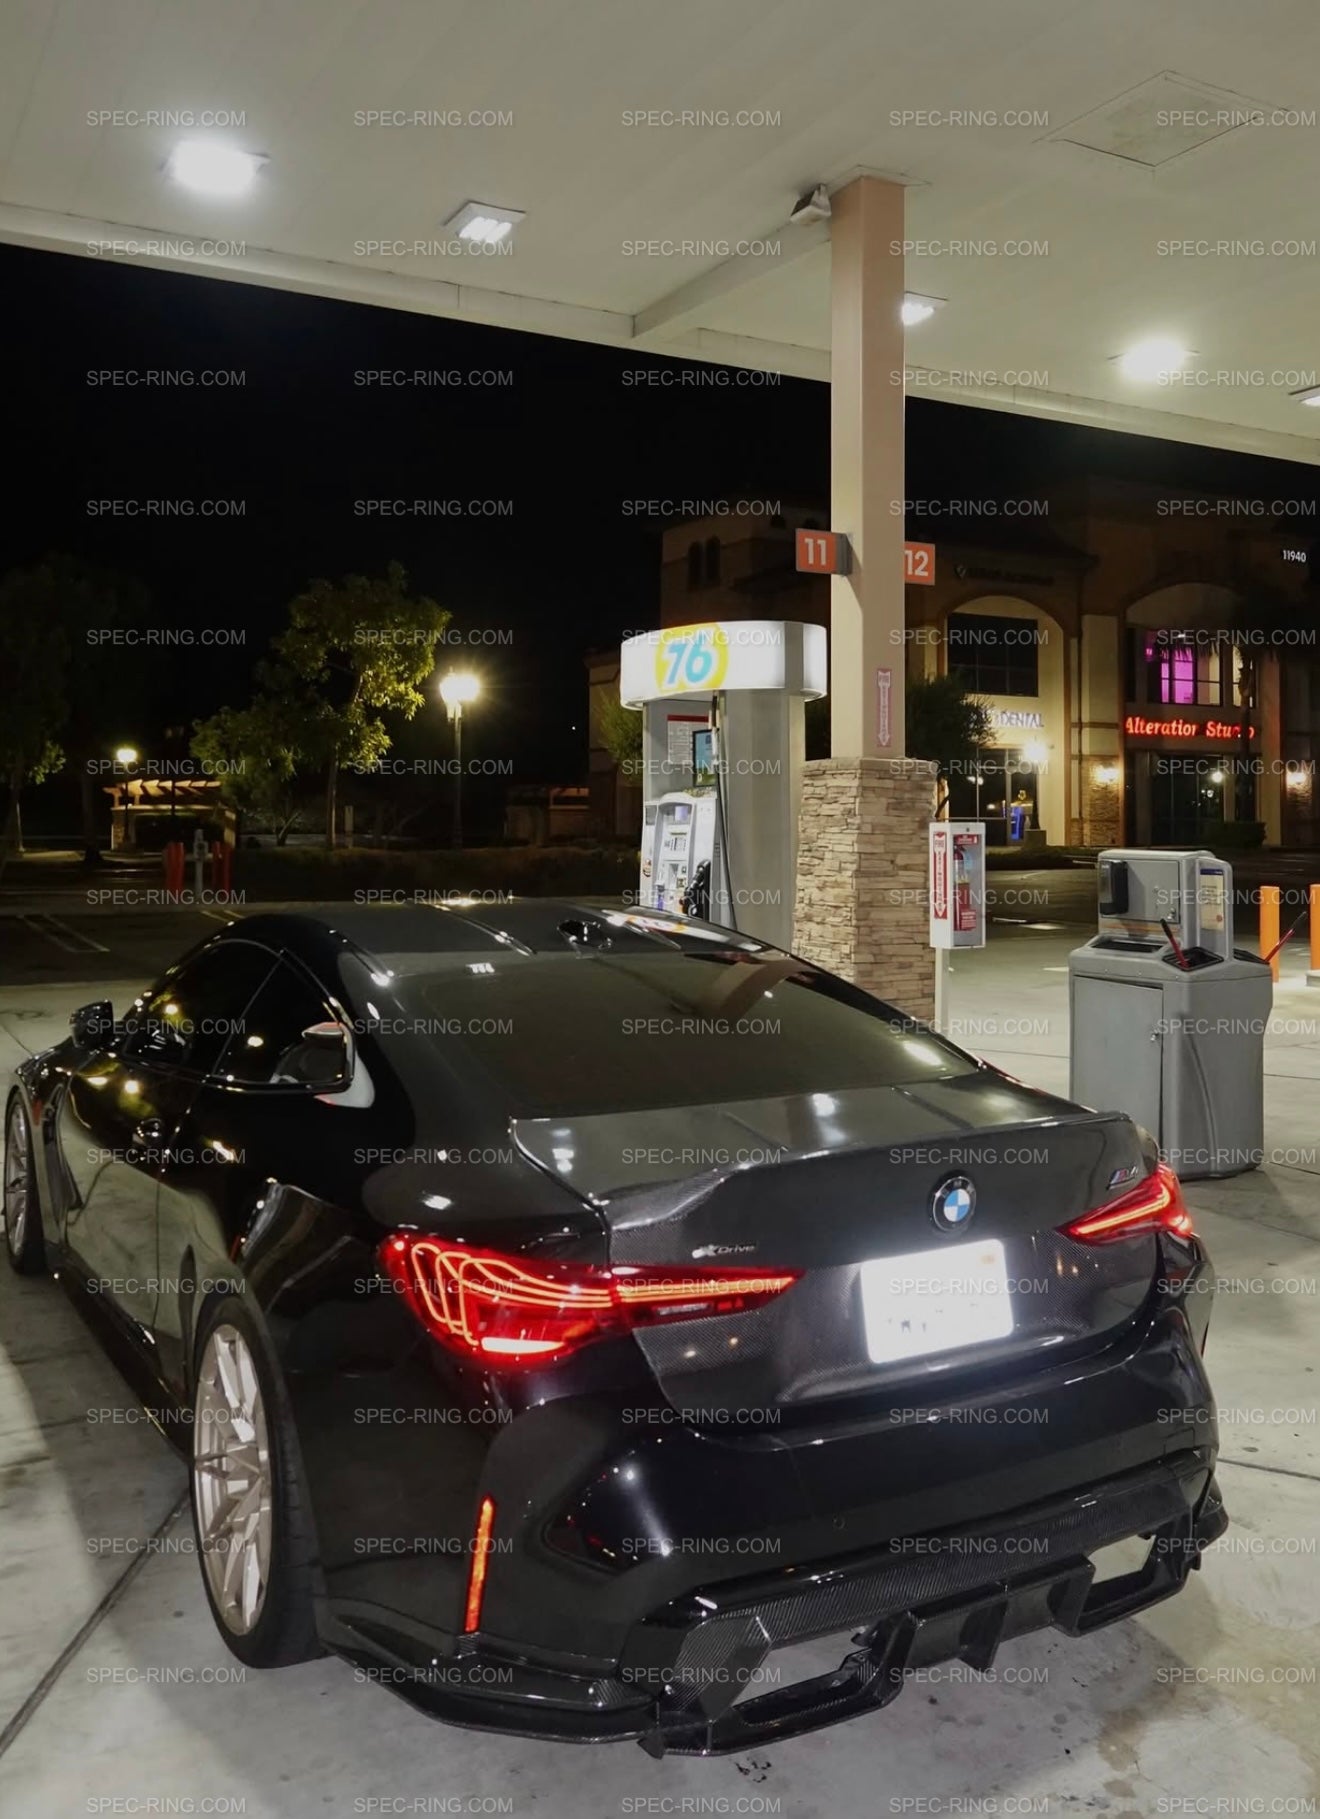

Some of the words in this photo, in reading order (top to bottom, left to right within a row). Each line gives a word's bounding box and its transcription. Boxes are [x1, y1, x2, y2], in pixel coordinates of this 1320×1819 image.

[804, 537, 827, 566] 11
[904, 549, 929, 577] 12
[1283, 549, 1307, 563] 11940
[665, 630, 714, 685] 76
[1001, 711, 1045, 728] DENTAL
